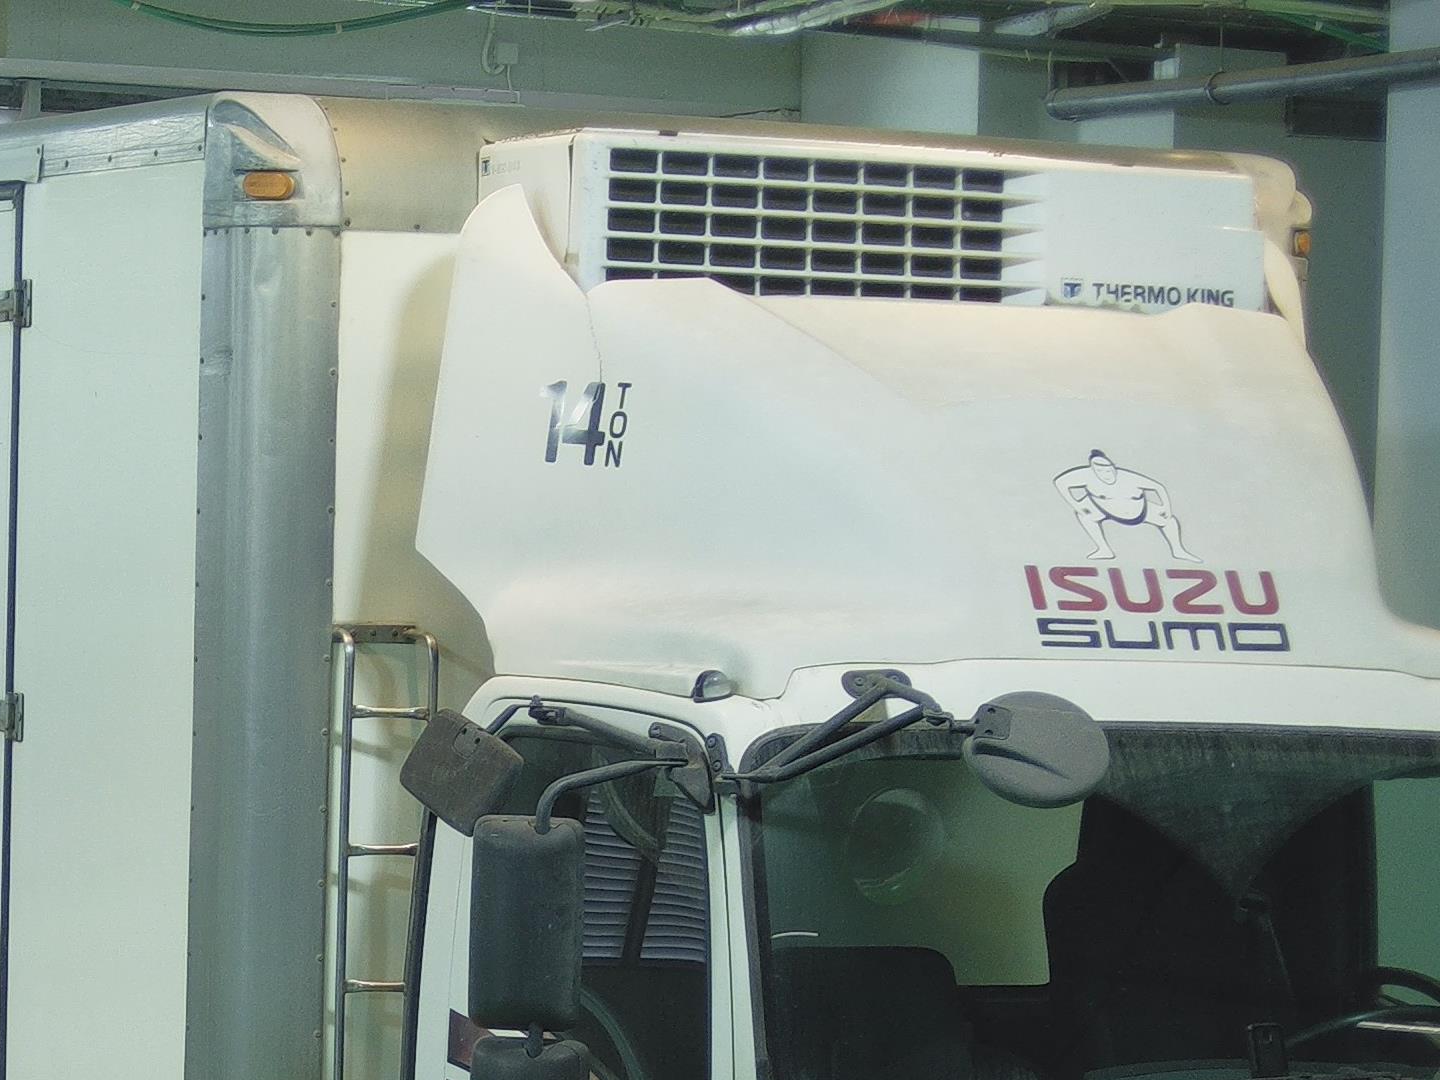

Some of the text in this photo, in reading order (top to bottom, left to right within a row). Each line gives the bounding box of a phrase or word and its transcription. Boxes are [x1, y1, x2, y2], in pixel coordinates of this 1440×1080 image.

[1092, 282, 1181, 306] THERMO
[1186, 287, 1235, 308] KING
[540, 380, 632, 467] 14 TON
[1023, 564, 1280, 615] ISUZU
[1036, 617, 1291, 652] SUMO
